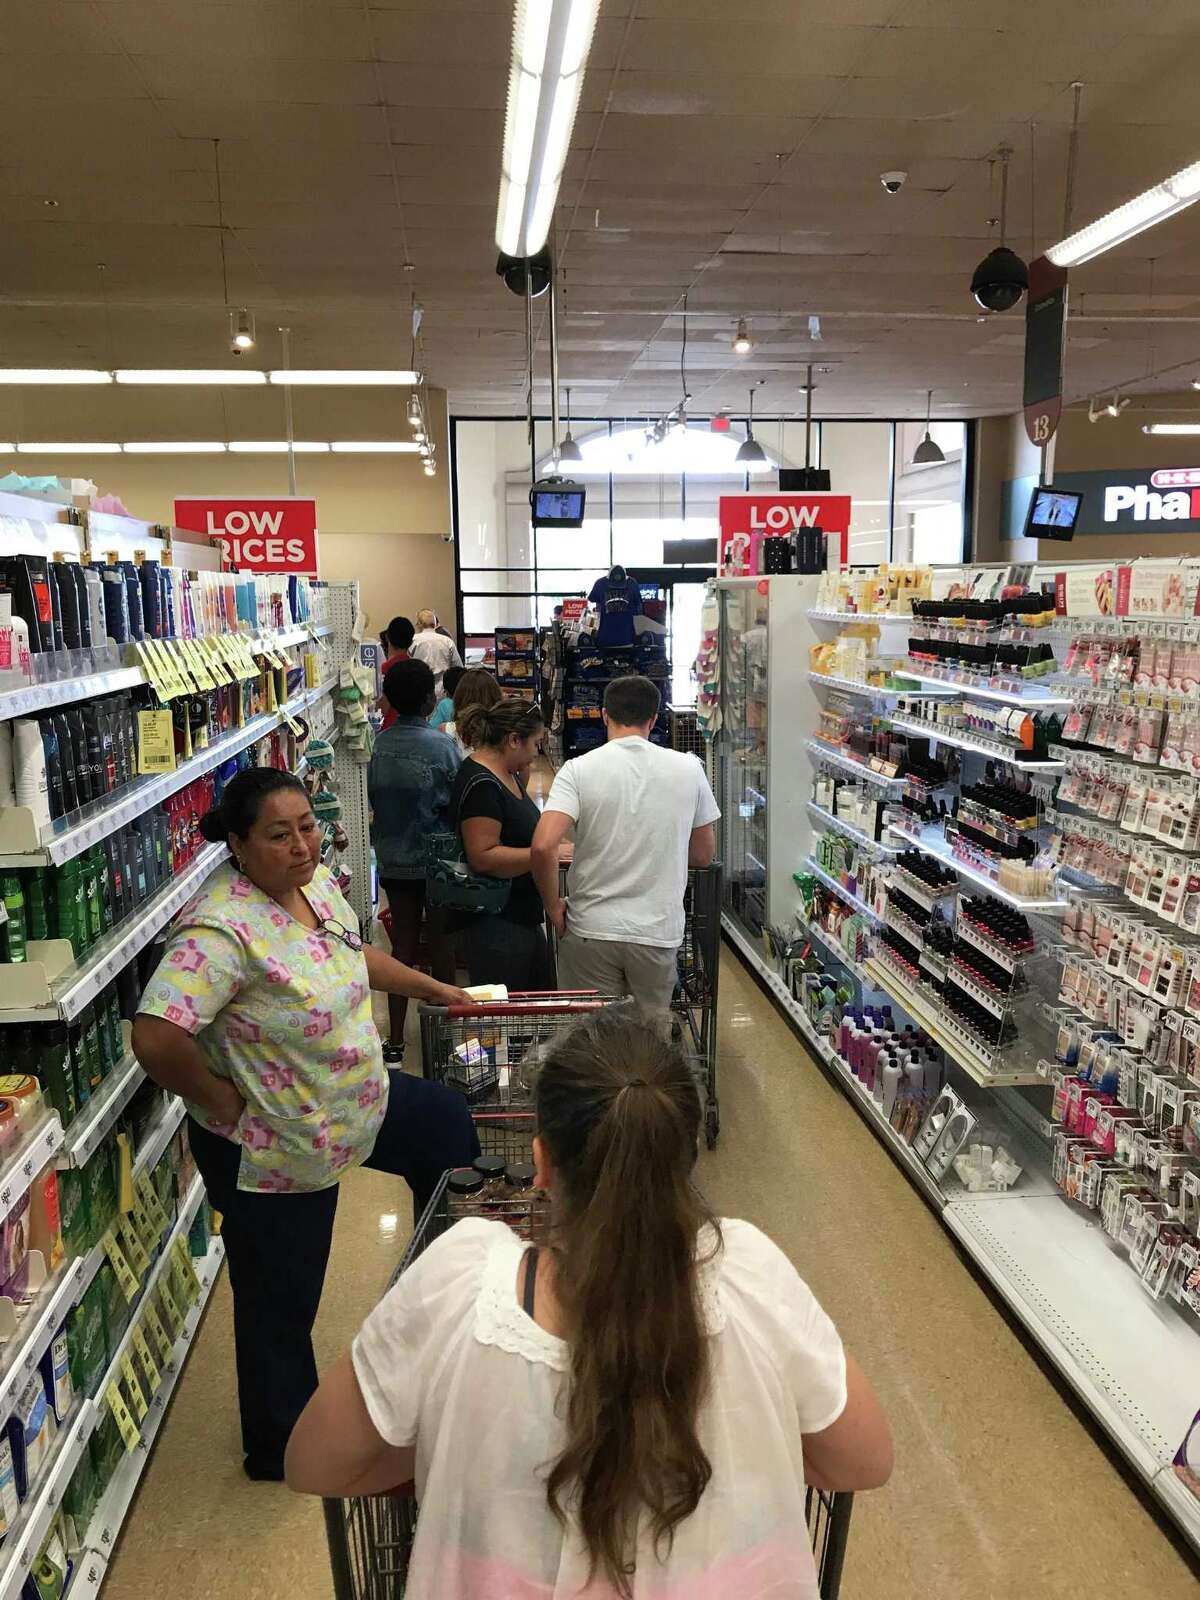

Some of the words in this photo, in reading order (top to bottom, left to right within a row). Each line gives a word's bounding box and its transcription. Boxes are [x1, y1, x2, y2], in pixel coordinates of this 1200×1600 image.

[1033, 415, 1049, 441] 13
[206, 510, 284, 536] LOW
[750, 505, 821, 529] LOW
[222, 538, 306, 563] RICES
